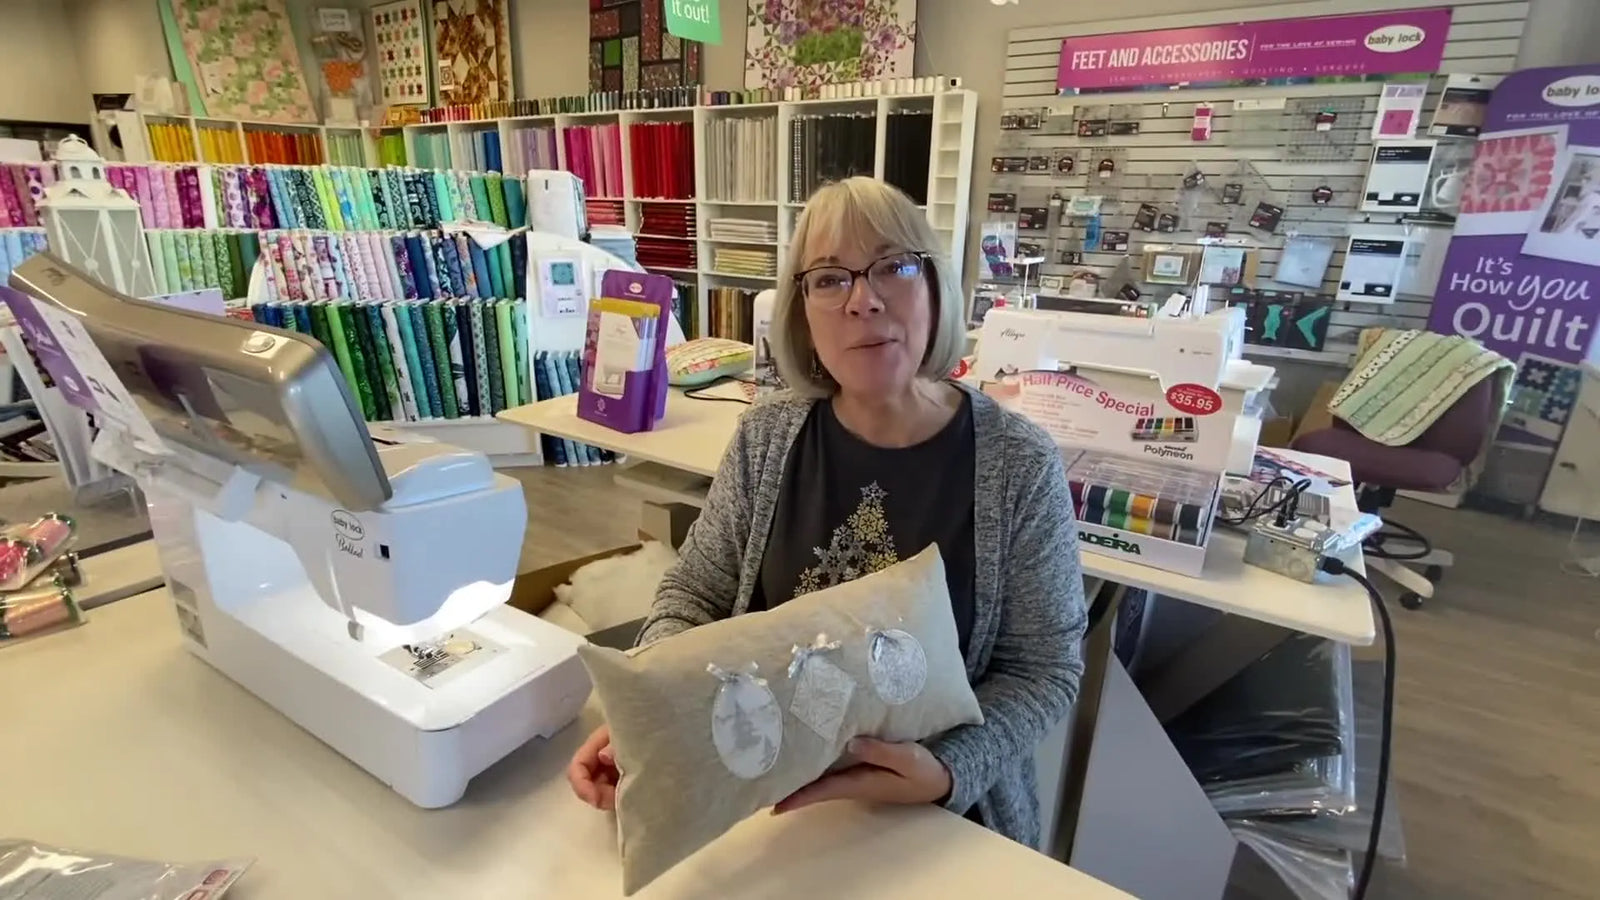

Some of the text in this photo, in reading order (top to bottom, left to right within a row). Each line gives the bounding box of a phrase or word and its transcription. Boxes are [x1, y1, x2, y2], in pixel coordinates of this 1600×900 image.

[684, 4, 710, 24] out!
[1368, 30, 1422, 48] baby lock
[1072, 39, 1249, 70] FEET AND ACCESSORIES
[1546, 85, 1600, 98] baby lo
[1475, 256, 1514, 275] It's
[1450, 272, 1591, 311] How you
[1452, 302, 1589, 351] Quilt
[1056, 375, 1094, 399] Price
[1096, 391, 1155, 417] Special
[1170, 391, 1214, 411] $35.95
[1143, 445, 1194, 461] Polyneon
[1078, 530, 1141, 554] ADEIRA
